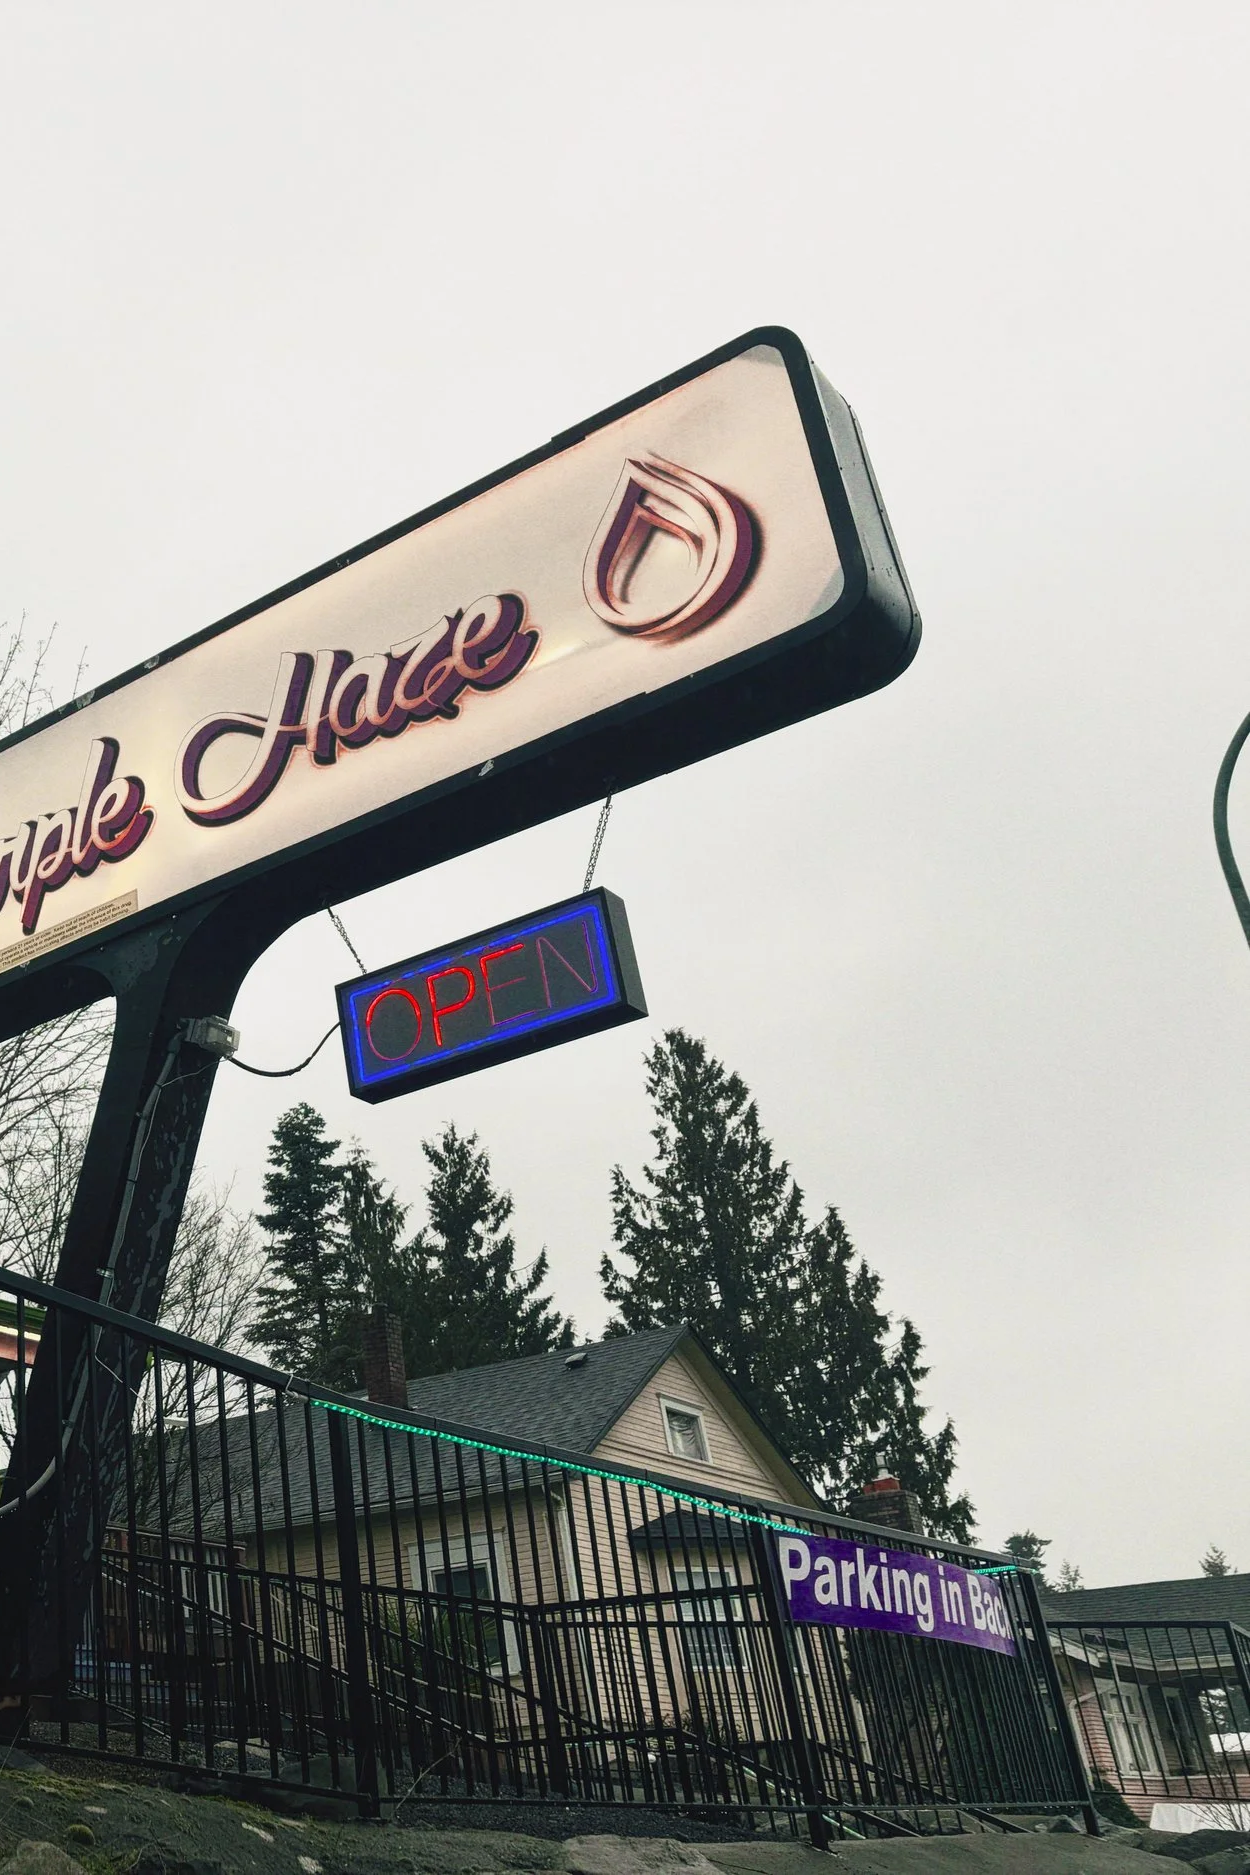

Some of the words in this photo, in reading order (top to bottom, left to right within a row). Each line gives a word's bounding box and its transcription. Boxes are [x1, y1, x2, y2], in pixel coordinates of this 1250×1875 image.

[173, 592, 540, 828] Haze
[365, 919, 598, 1062] OPEN
[778, 1536, 935, 1632] Parking
[938, 1565, 966, 1626] in
